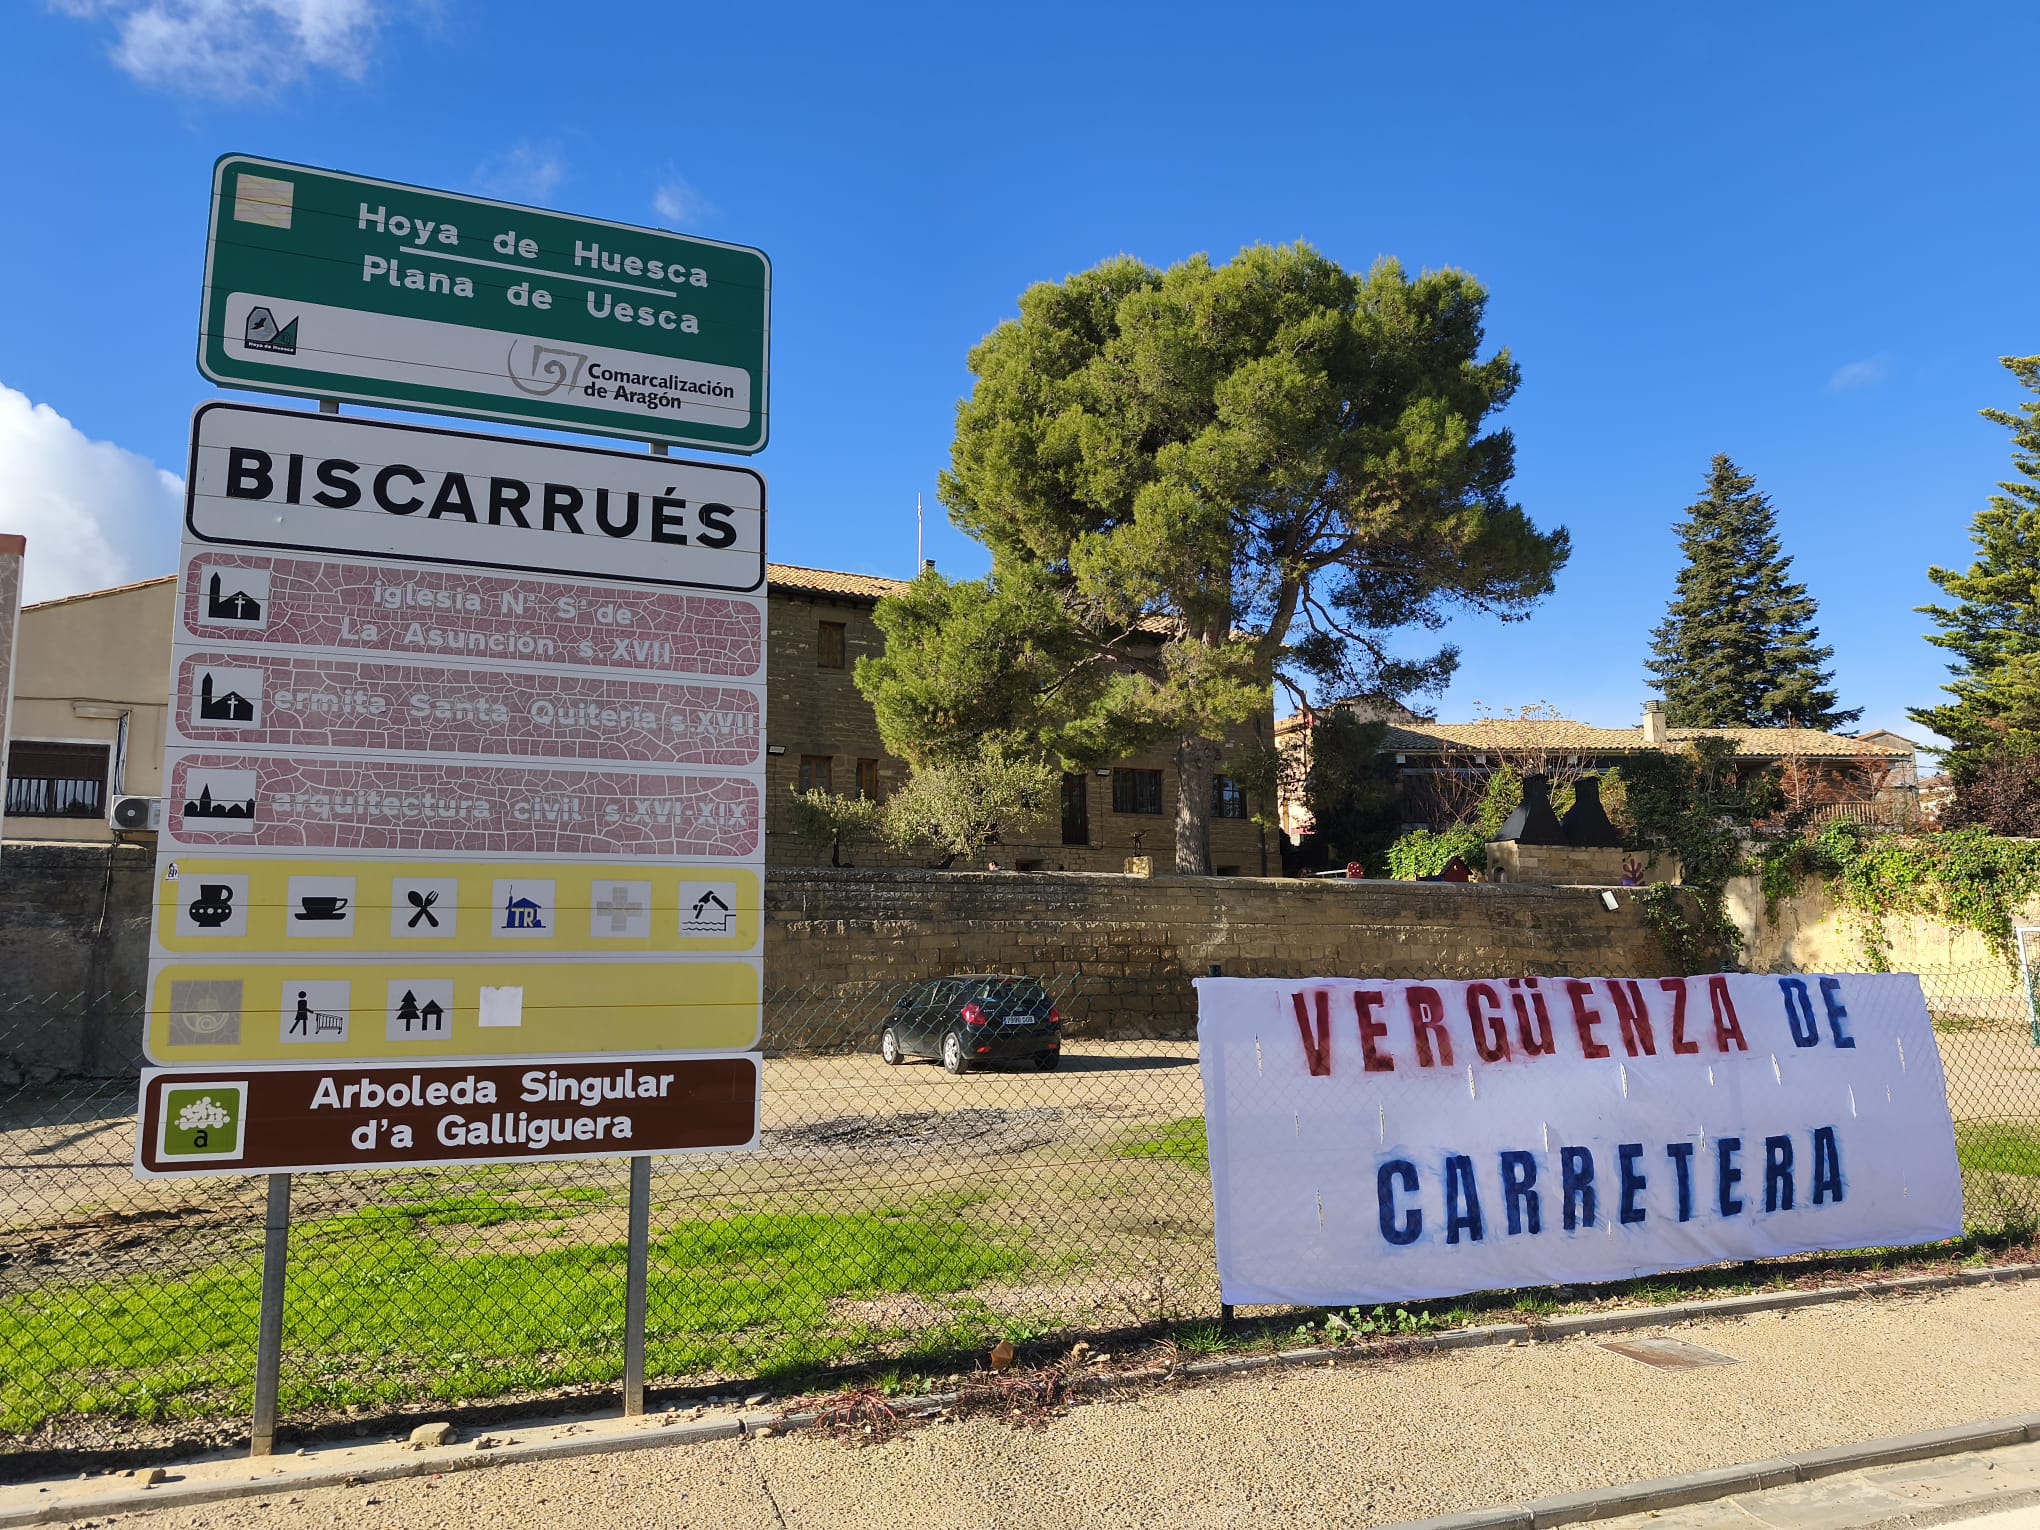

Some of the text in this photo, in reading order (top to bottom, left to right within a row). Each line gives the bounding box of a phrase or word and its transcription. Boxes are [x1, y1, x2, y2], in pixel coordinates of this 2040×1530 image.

[358, 202, 708, 288] Hoya de Huesca
[363, 255, 700, 335] Plana de Uesca
[584, 382, 681, 409] de Aragón
[588, 363, 734, 398] Comarcalización
[226, 447, 737, 549] BISCARRUÉS
[374, 580, 481, 611] iglesia
[597, 603, 631, 625] de
[342, 617, 377, 641] La
[403, 622, 554, 655] Asunción
[274, 689, 386, 714] ermita
[410, 693, 508, 722] Santa
[531, 700, 656, 729] Quiteria
[273, 790, 490, 819] arquitectura
[514, 797, 582, 821] civil
[512, 908, 534, 927] TR
[1779, 976, 1857, 1049] DE
[310, 1069, 674, 1110] Arboleda Singular
[437, 1111, 633, 1159] Galliguera
[1377, 1126, 1844, 1246] CARRETERA
